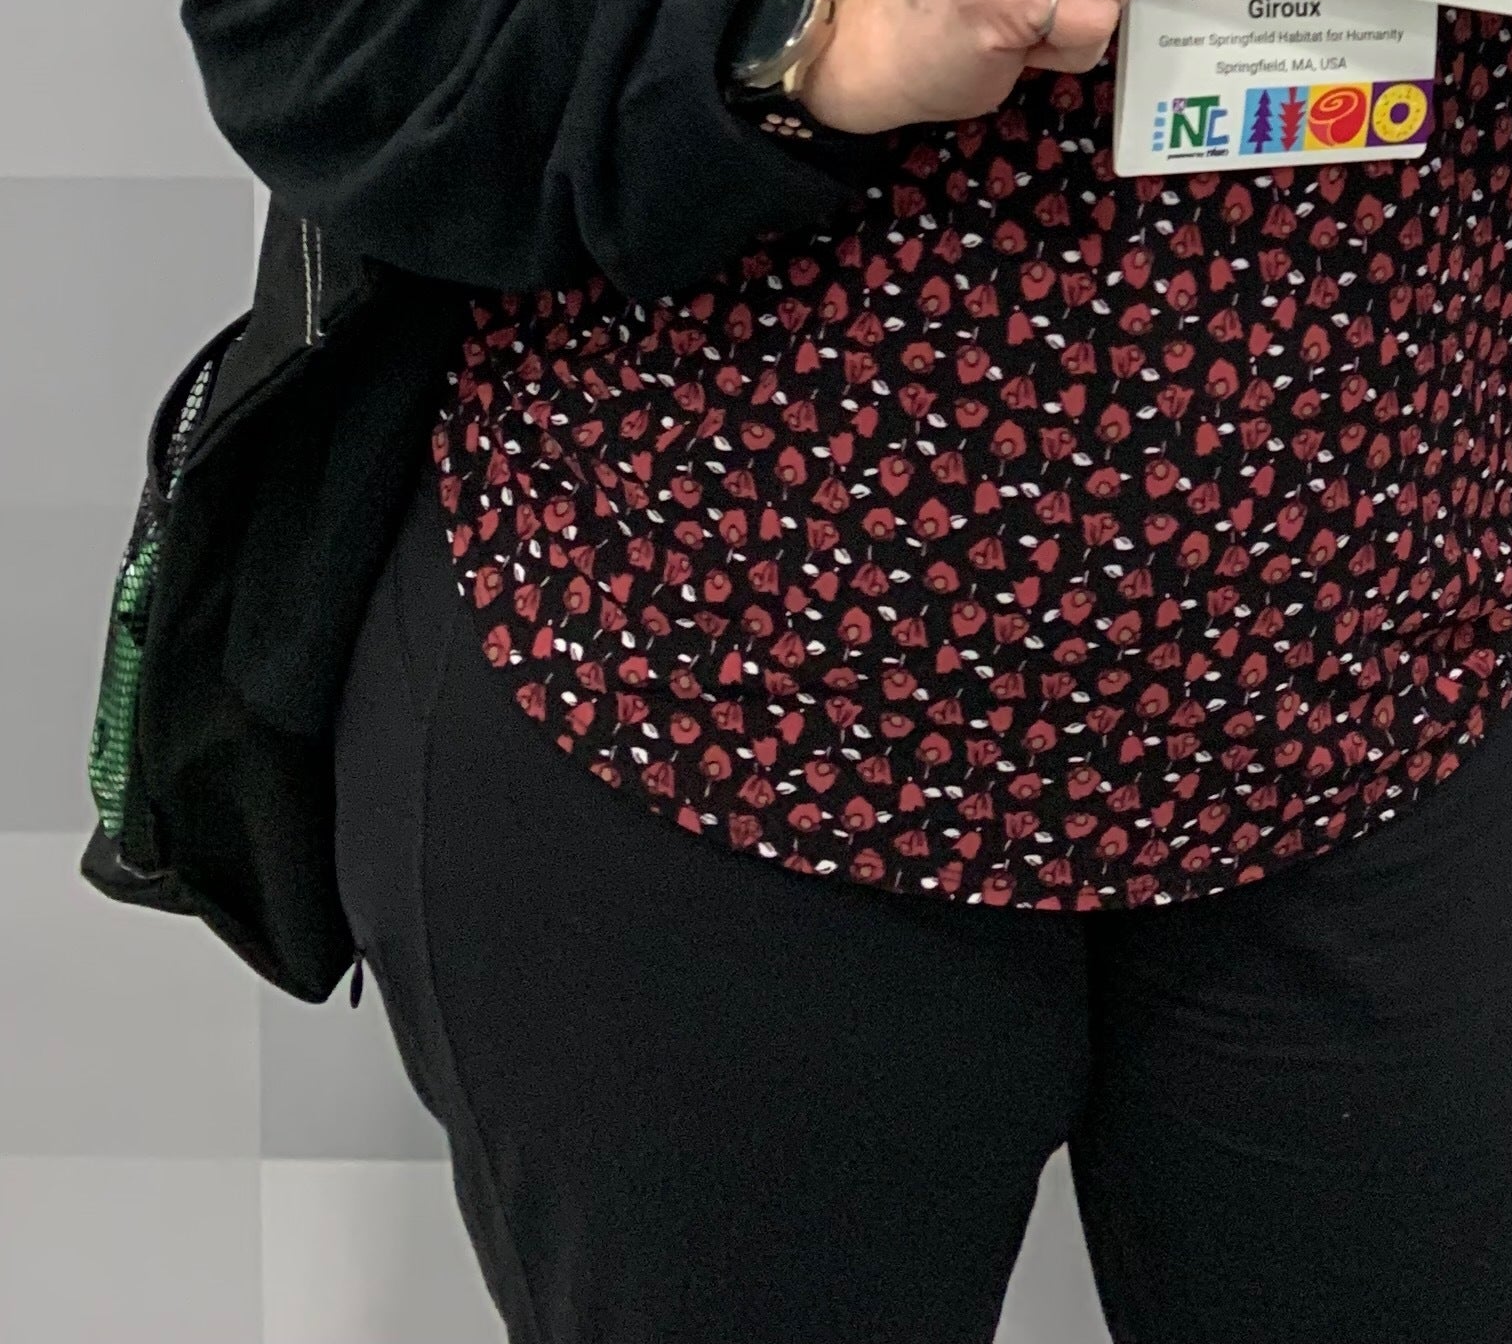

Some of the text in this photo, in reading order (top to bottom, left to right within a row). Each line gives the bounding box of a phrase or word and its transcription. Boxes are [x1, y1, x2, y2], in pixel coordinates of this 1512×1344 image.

[1158, 28, 1404, 48] Greater Springfield Habitat for Humanity
[1216, 57, 1347, 77] Springfield, MA, USA
